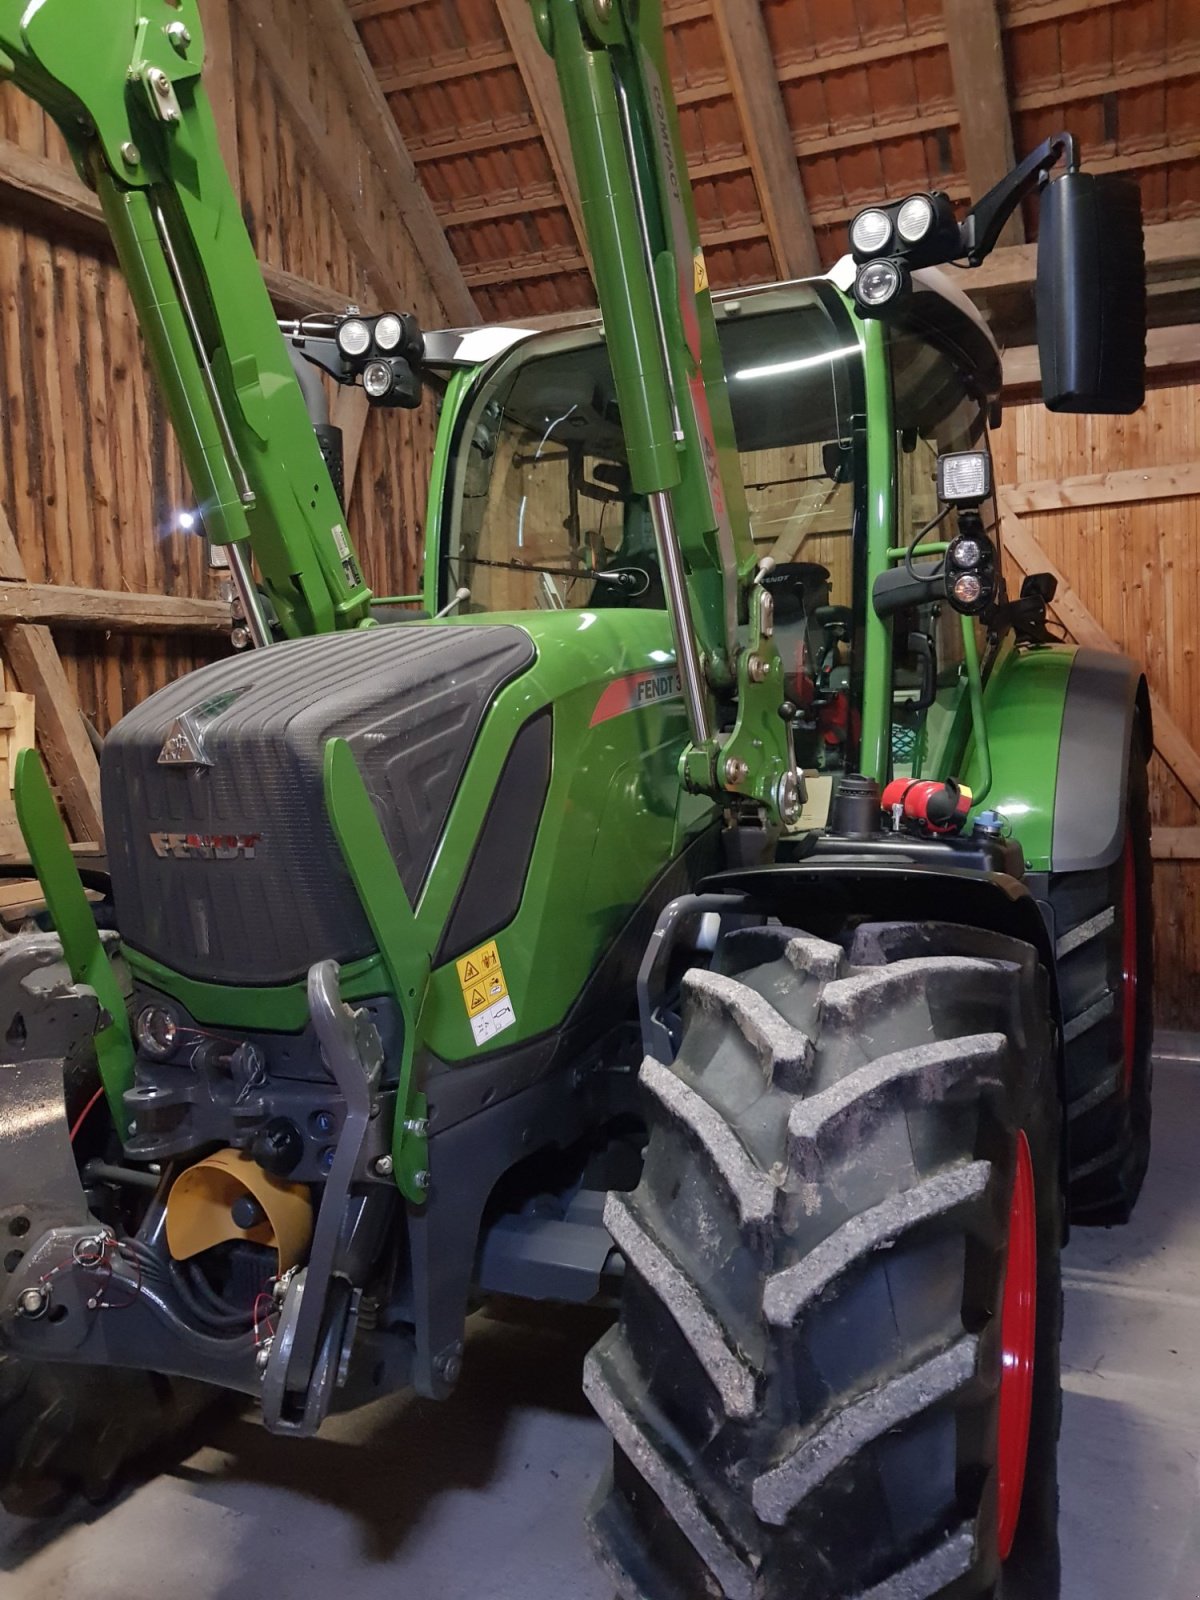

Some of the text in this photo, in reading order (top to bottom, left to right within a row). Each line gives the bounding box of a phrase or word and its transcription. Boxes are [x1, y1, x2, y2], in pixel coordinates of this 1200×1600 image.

[652, 85, 681, 203] COMPACT
[760, 574, 790, 583] FENDT
[637, 675, 675, 701] FENDT
[149, 831, 264, 859] FENDT
